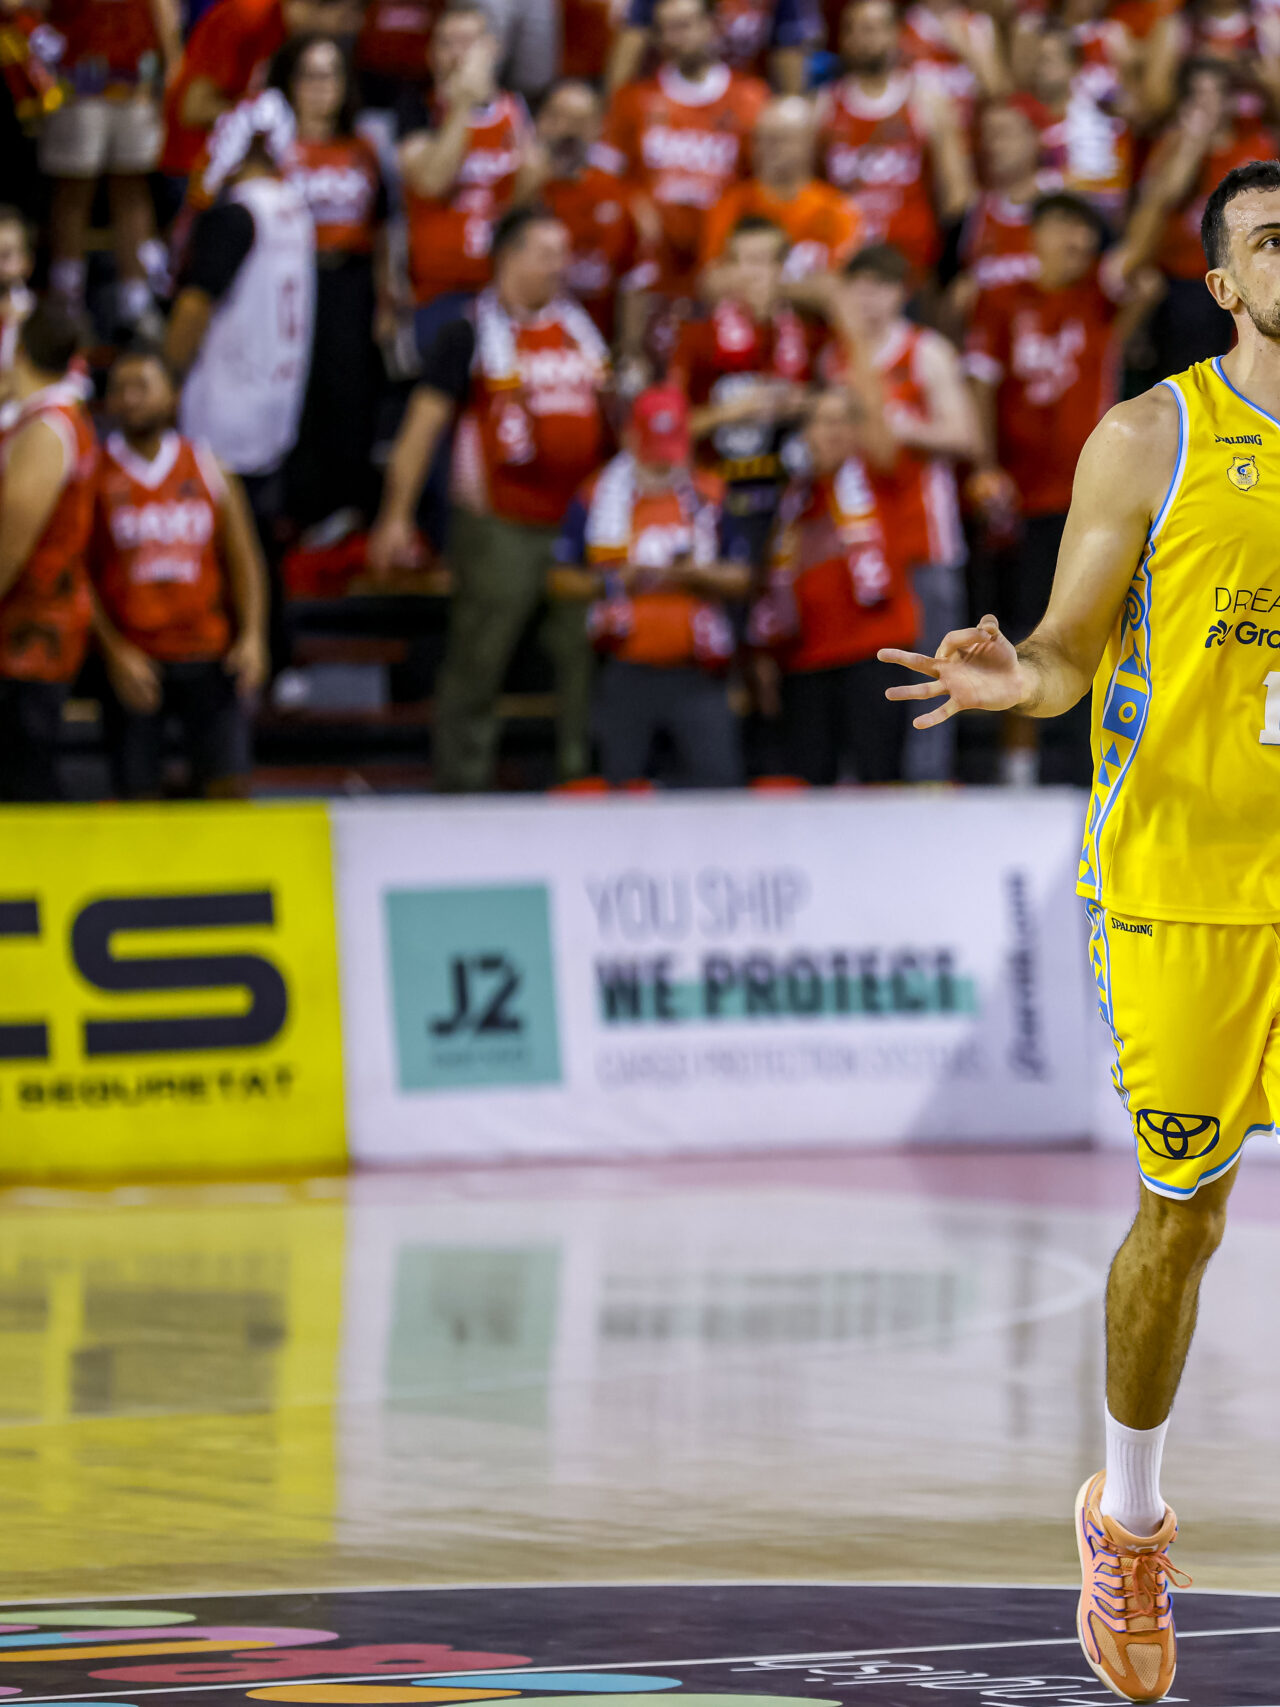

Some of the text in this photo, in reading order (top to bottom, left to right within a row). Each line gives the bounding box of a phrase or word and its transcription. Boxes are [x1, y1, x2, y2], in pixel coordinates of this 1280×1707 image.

[585, 865, 808, 938] YOU SHIP
[1111, 917, 1152, 937] SPALDING
[427, 952, 524, 1038] J2
[597, 944, 957, 1027] WE PROTECT
